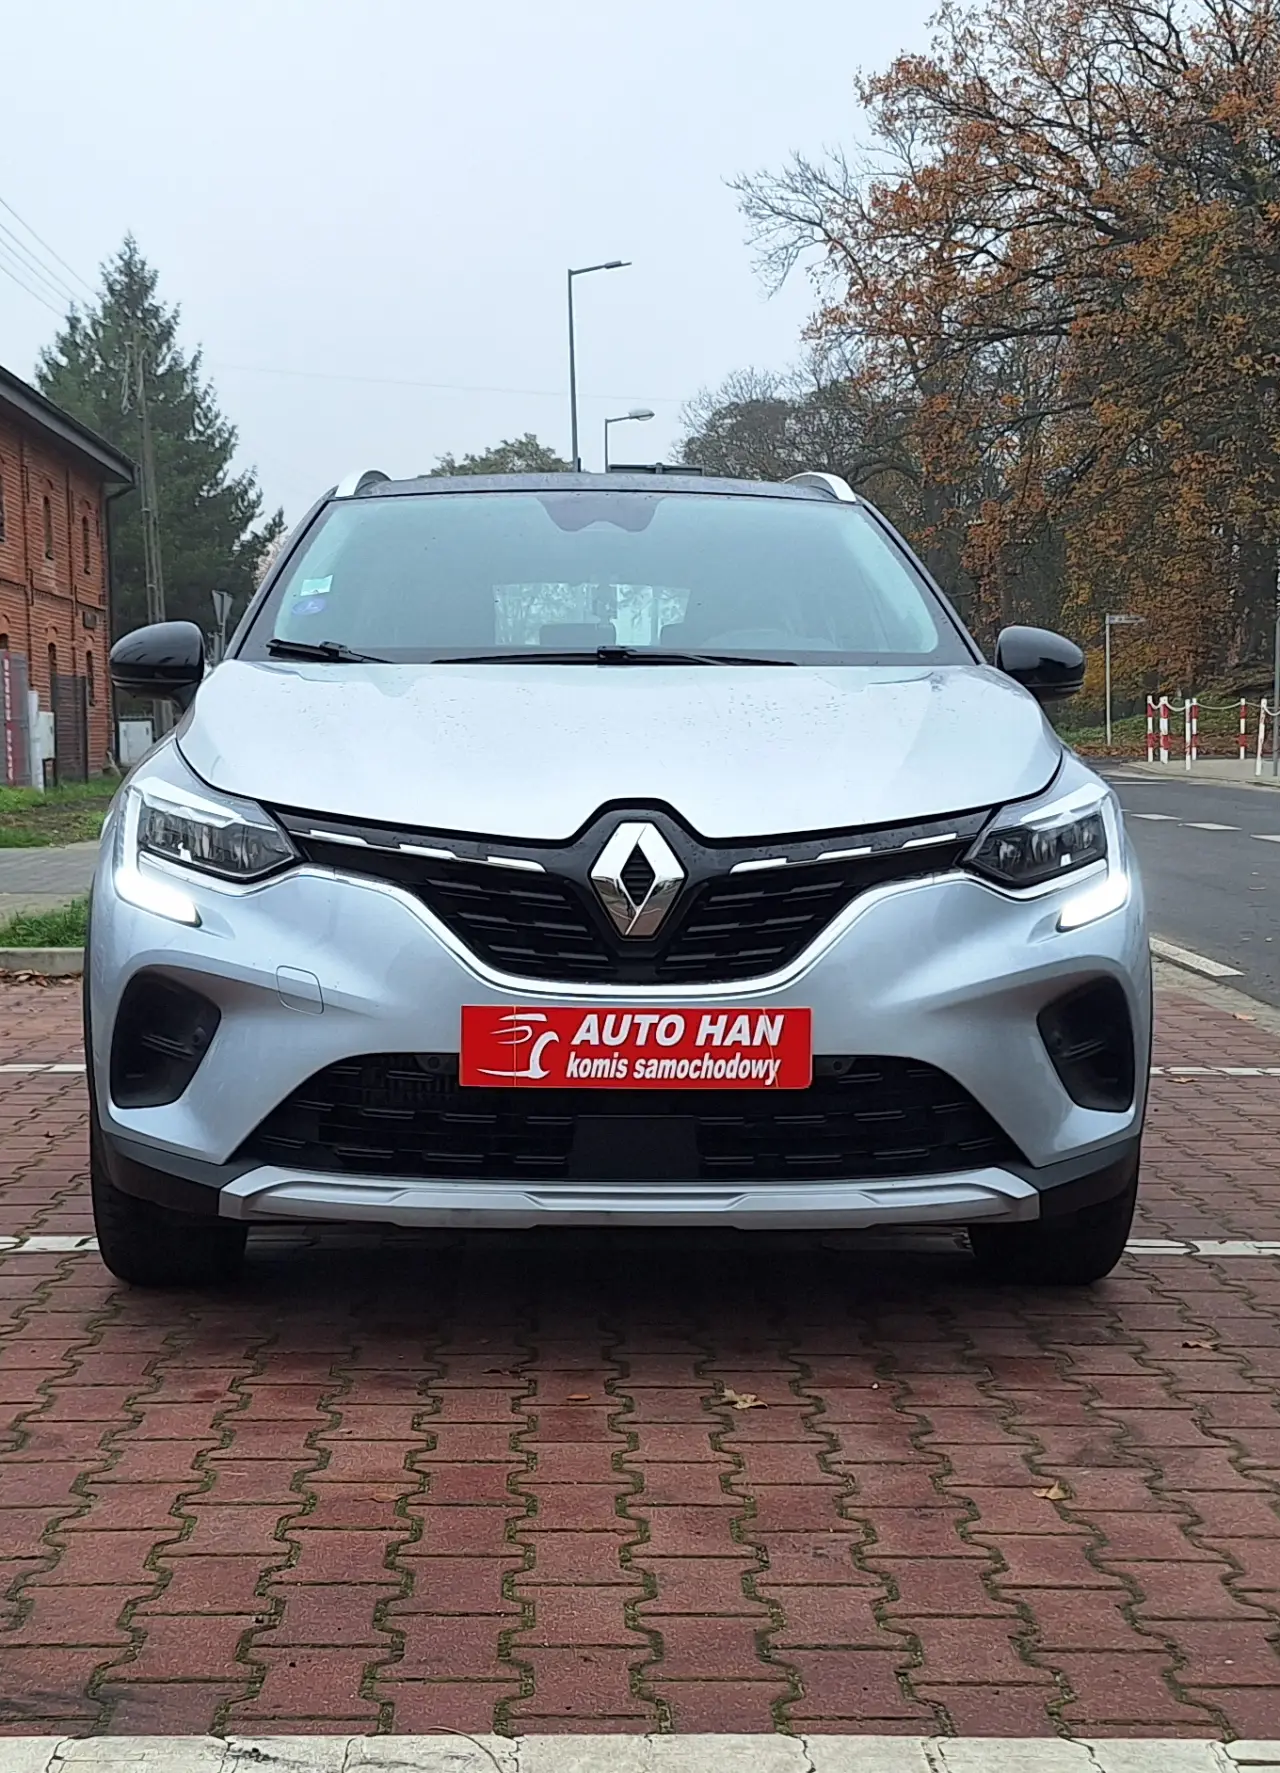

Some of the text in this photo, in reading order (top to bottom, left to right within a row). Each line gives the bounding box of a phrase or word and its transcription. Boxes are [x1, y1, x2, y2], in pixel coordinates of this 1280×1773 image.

[571, 1013, 785, 1047] AUTO HAN
[566, 1051, 781, 1086] komis samochodowy
